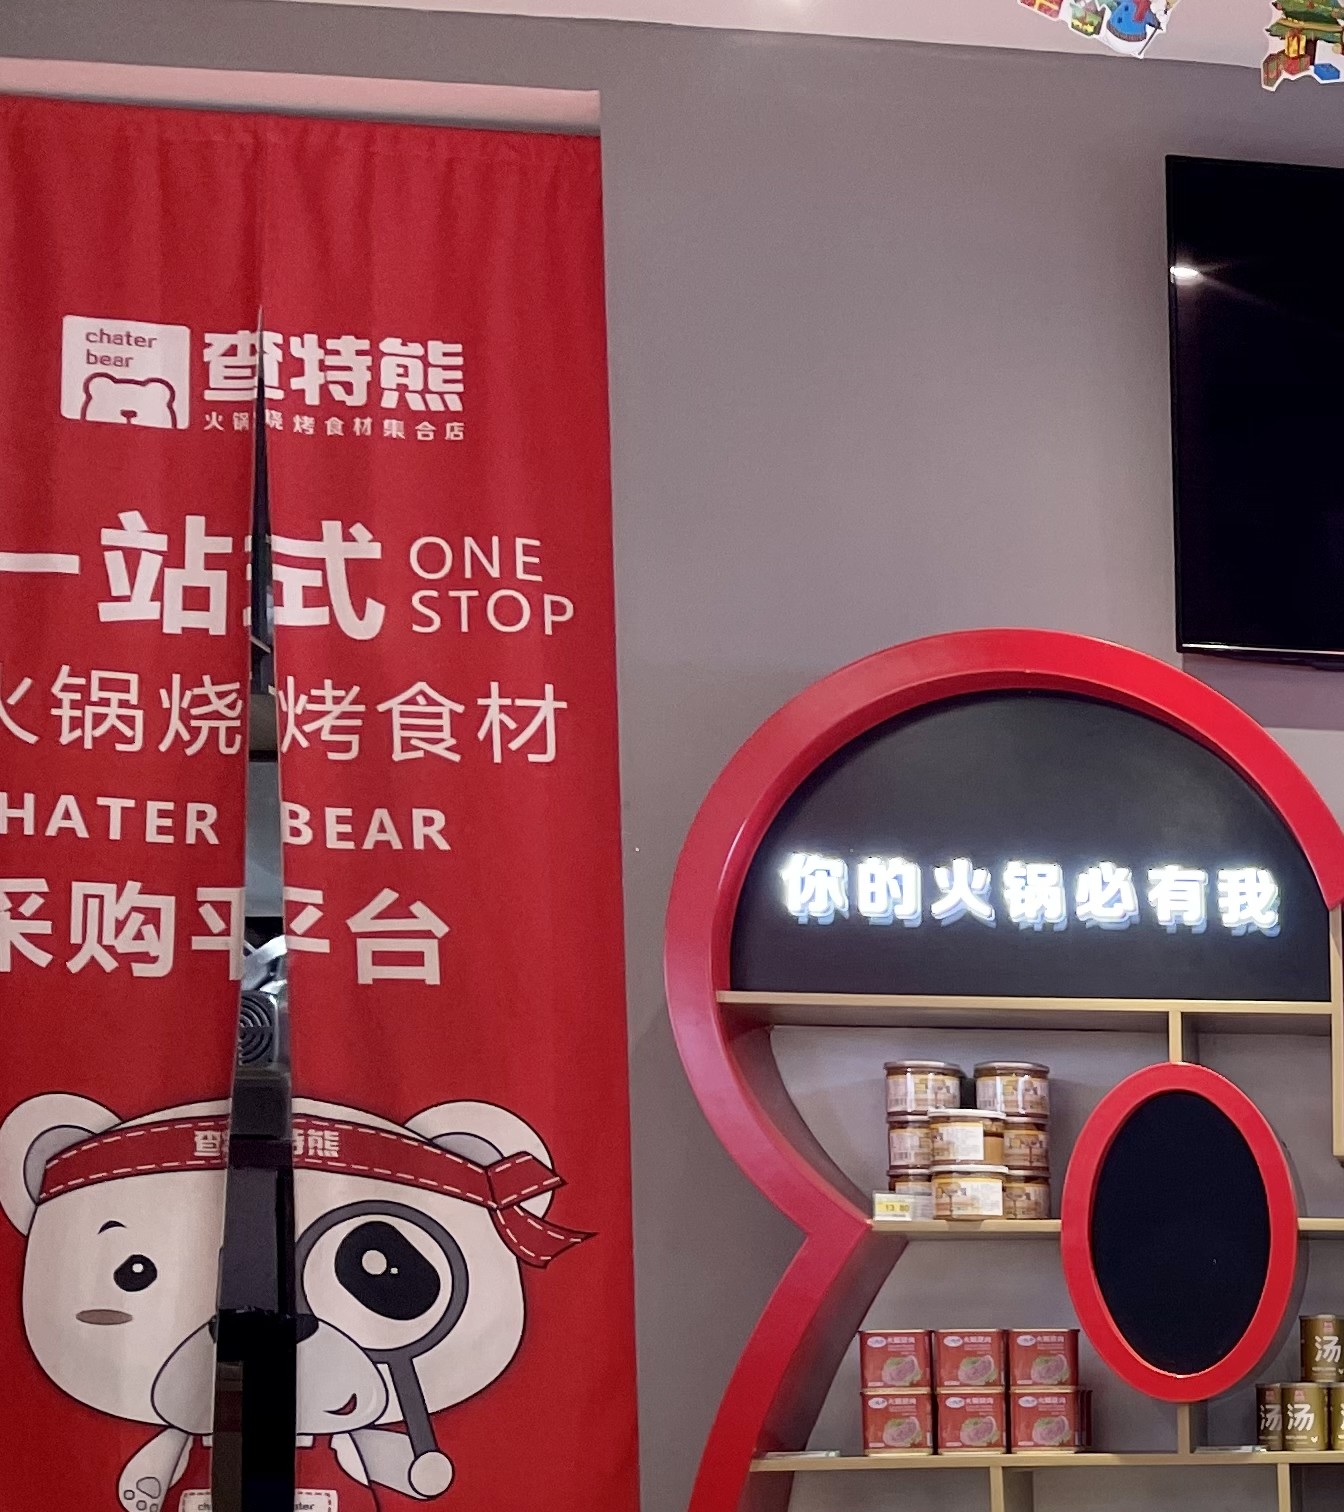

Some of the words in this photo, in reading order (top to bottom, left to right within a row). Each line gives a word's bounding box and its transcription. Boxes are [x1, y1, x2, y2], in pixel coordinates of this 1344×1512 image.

[85, 329, 157, 349] chater
[85, 351, 134, 369] bear
[203, 328, 465, 411] 查特熊
[0, 510, 386, 640] 一站式
[410, 536, 543, 582] ONE
[411, 589, 574, 636] STOP
[281, 804, 452, 851] BEAR
[781, 853, 1280, 930] 你的火锅必有我
[0, 878, 450, 985] 采购平台
[1315, 1335, 1342, 1363] 汤
[1287, 1403, 1315, 1431] 汤
